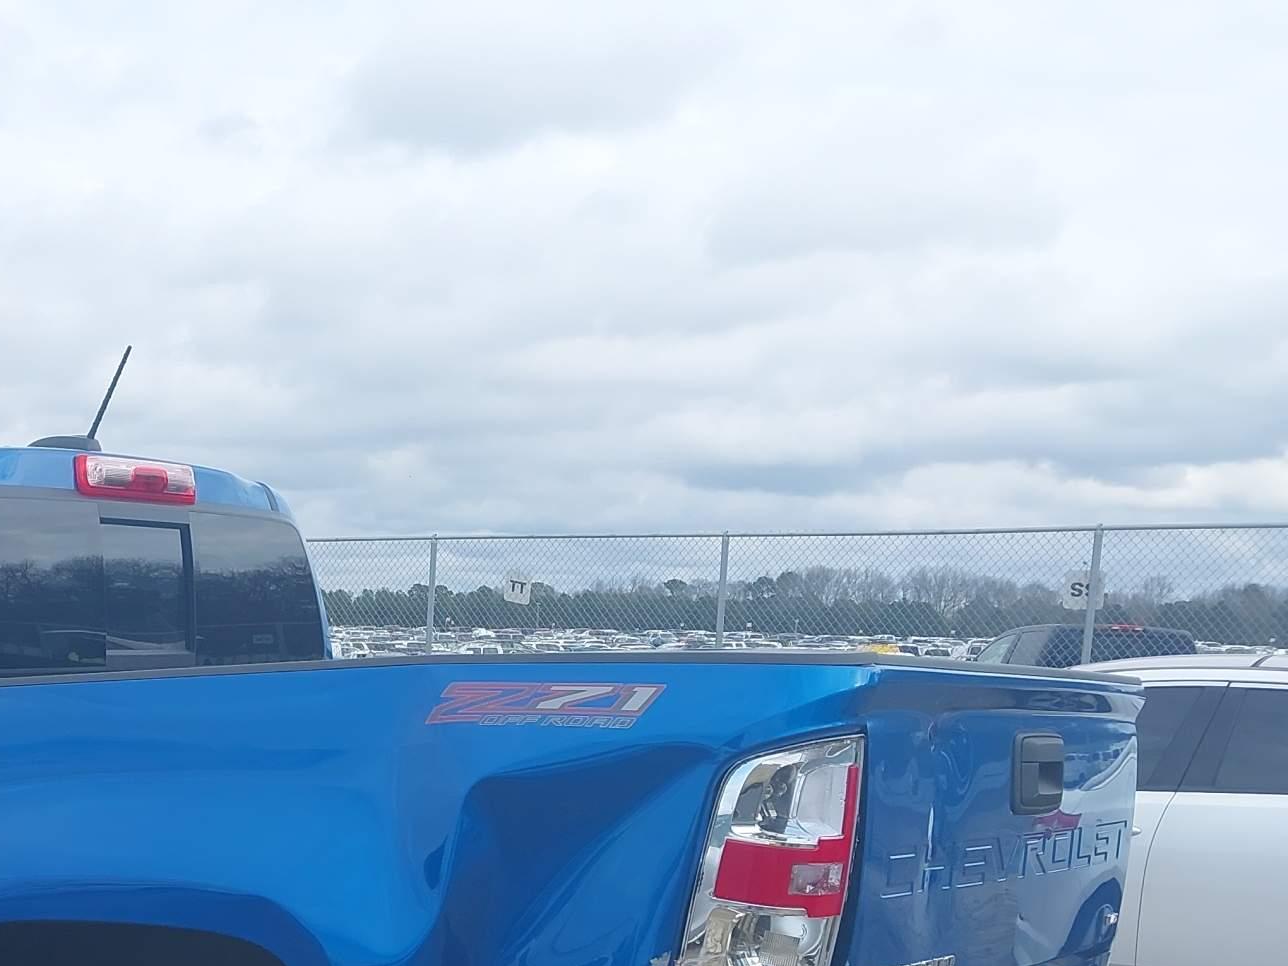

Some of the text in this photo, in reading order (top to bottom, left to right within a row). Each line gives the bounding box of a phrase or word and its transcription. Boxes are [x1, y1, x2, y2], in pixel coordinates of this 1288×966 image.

[510, 579, 527, 594] TT
[1071, 582, 1089, 597] S
[425, 682, 667, 724] Z71
[479, 714, 638, 729] OFF ROAD
[880, 820, 1127, 899] CHEVROLET
